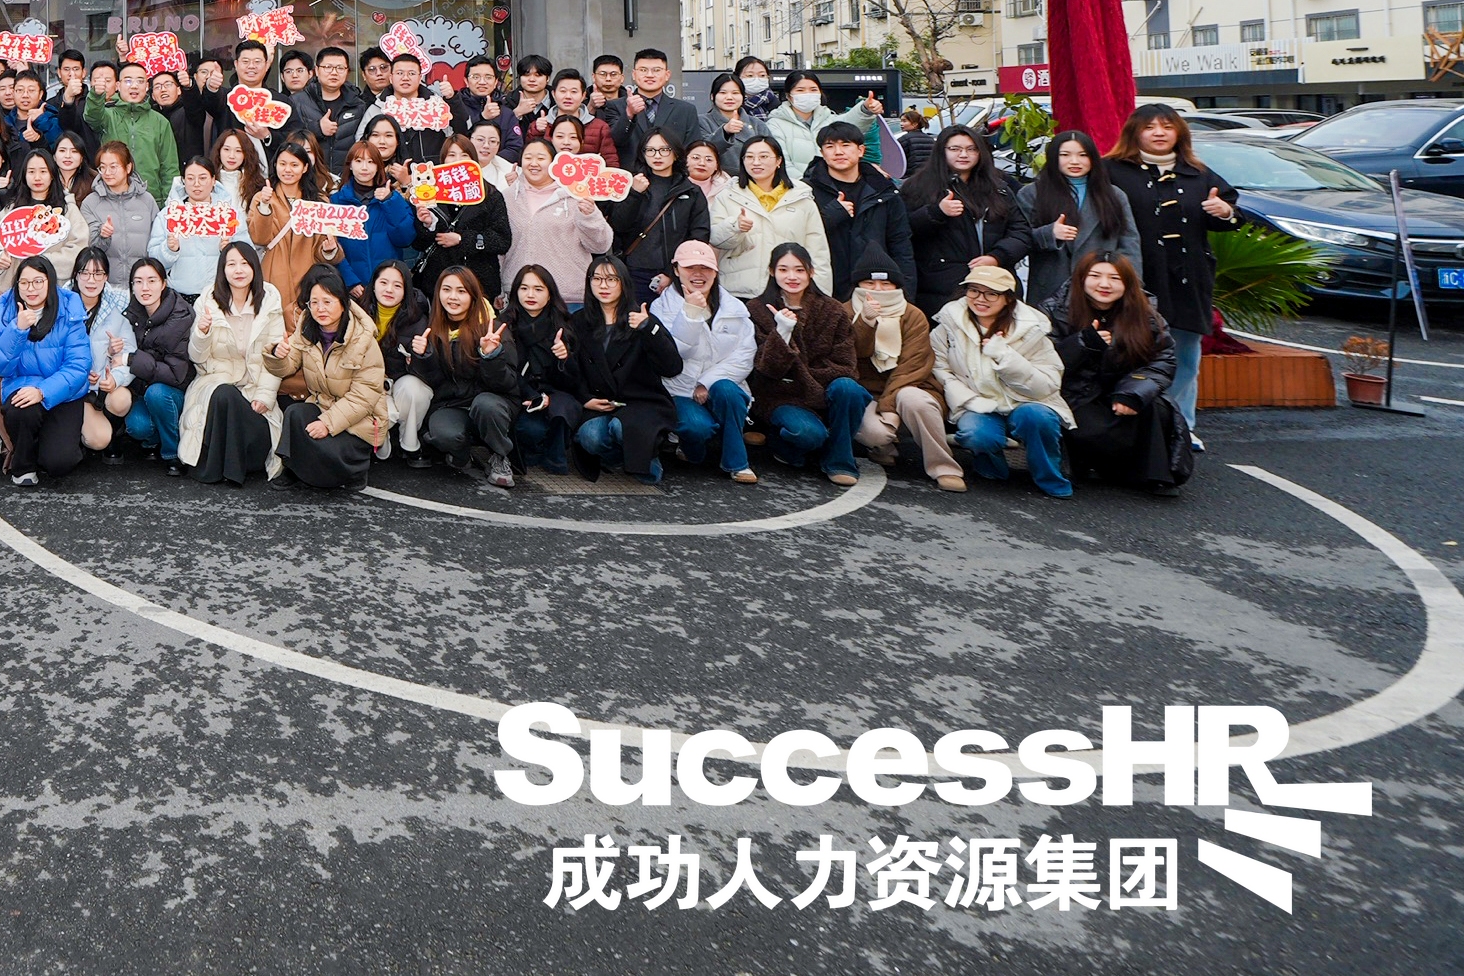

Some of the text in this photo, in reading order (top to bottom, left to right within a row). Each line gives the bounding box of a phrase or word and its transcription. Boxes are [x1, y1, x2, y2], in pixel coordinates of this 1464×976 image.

[1, 33, 48, 49] 马力全开
[1165, 56, 1190, 73] We
[1197, 53, 1238, 71] Walk
[438, 165, 470, 185] 有钱
[581, 157, 601, 177] 有
[588, 173, 629, 197] 钱花
[292, 201, 368, 221] 加油2026
[0, 218, 28, 236] 红红
[173, 220, 231, 239] 火力全开
[295, 216, 367, 239] 我们一起赢
[3, 232, 30, 248] 火火
